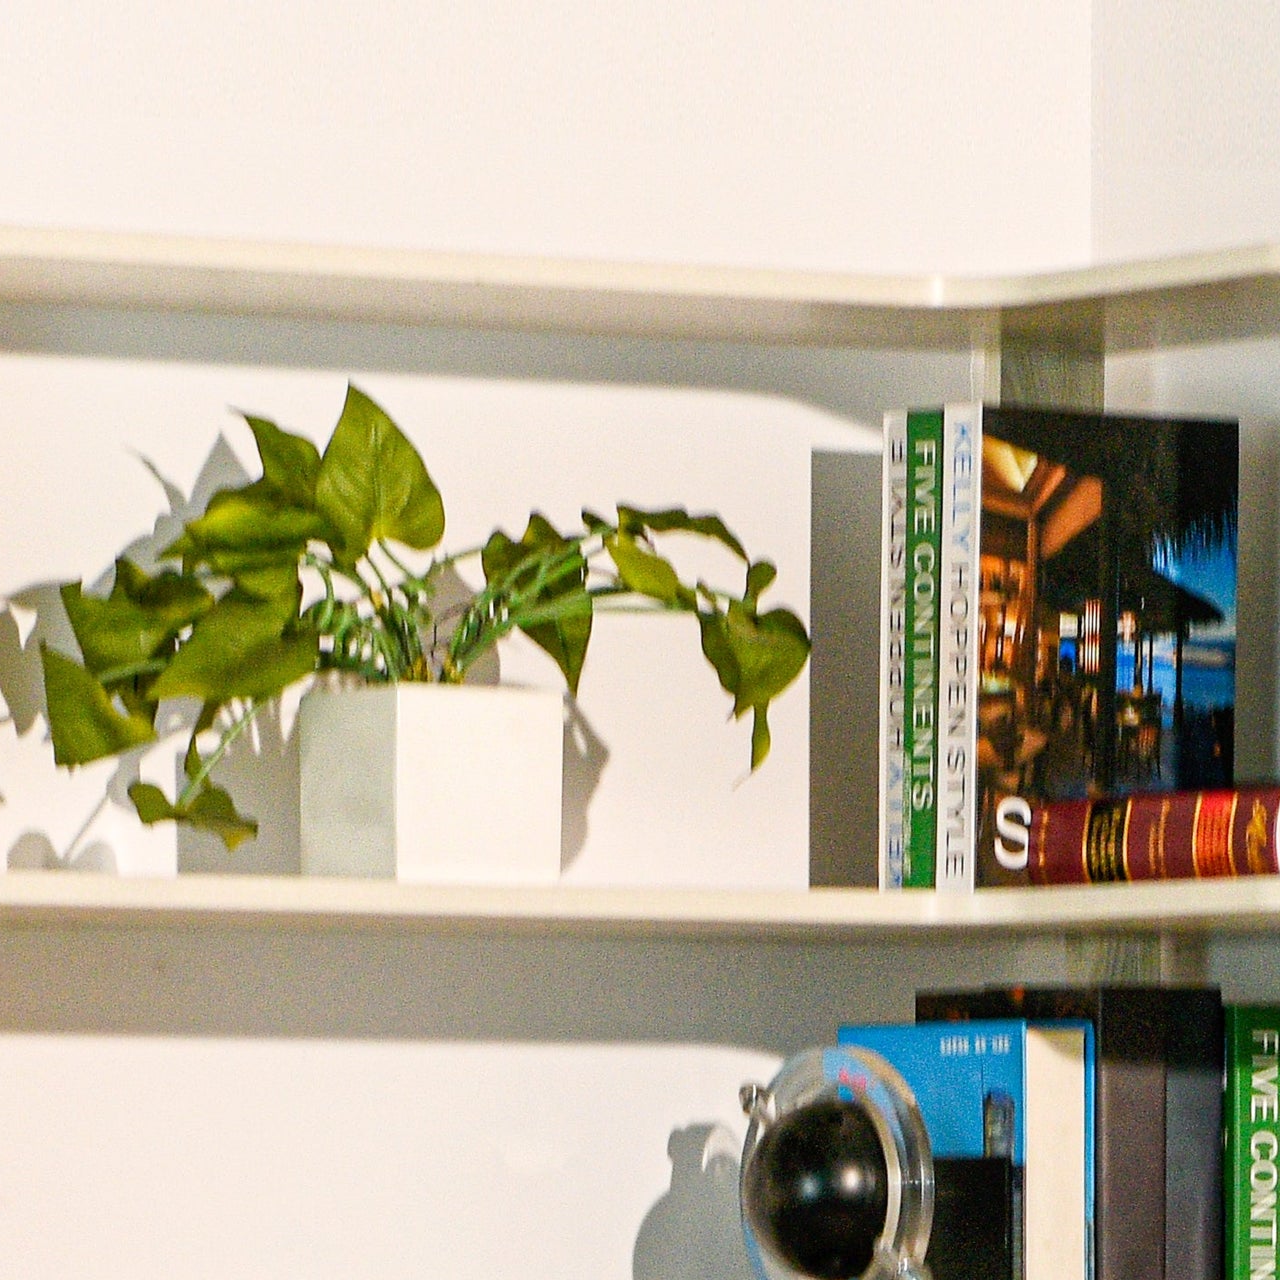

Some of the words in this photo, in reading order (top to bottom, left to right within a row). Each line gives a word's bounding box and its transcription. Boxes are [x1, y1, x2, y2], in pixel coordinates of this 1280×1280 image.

[913, 438, 936, 533] FIVE
[952, 421, 972, 552] KELLY
[910, 543, 935, 812] CONTINENTS
[947, 560, 969, 738] HOPPEN
[945, 745, 966, 879] STYLE
[1250, 1028, 1280, 1122] FIVE
